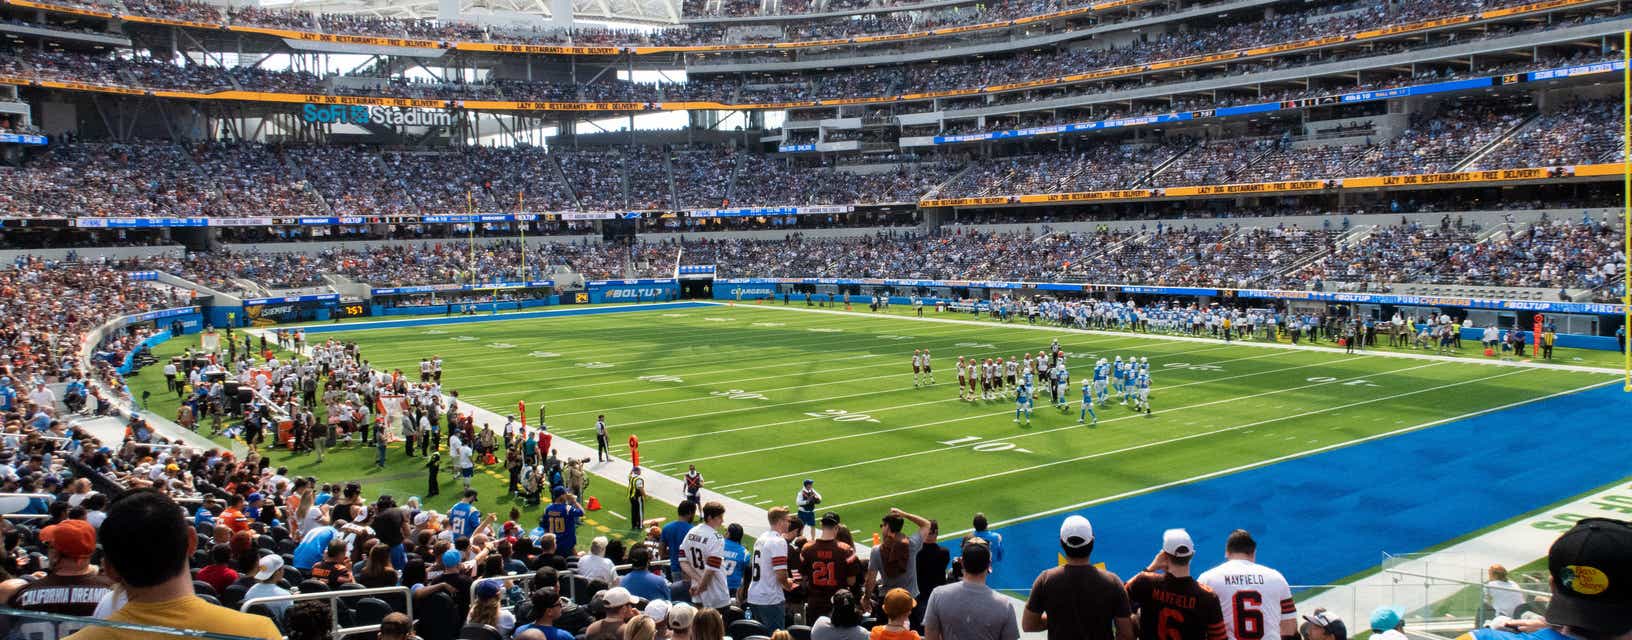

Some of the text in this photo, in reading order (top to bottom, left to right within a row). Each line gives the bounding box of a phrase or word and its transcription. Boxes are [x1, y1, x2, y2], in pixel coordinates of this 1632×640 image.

[336, 36, 378, 44] RESTAURANTS
[341, 96, 382, 105] RESTAURANTS
[304, 104, 451, 126] SoFi Stadium
[1384, 169, 1540, 185] LAZY DOG RESTAURANTS FREE DELIVERY!
[1228, 183, 1264, 192] RESTAURANTS
[1290, 181, 1318, 189] DELIVERY!
[346, 306, 363, 315] 7:57
[936, 436, 1016, 452] 10
[453, 517, 465, 534] 21
[549, 517, 565, 533] 10
[690, 547, 704, 570] 13
[753, 550, 761, 582] 6
[812, 562, 837, 586] 21
[1225, 574, 1264, 585] MAYFIELD
[20, 588, 69, 606] CALIFORNIA
[1152, 588, 1196, 608] MAYFIELD
[1232, 590, 1264, 640] 6
[1158, 608, 1184, 640] 6
